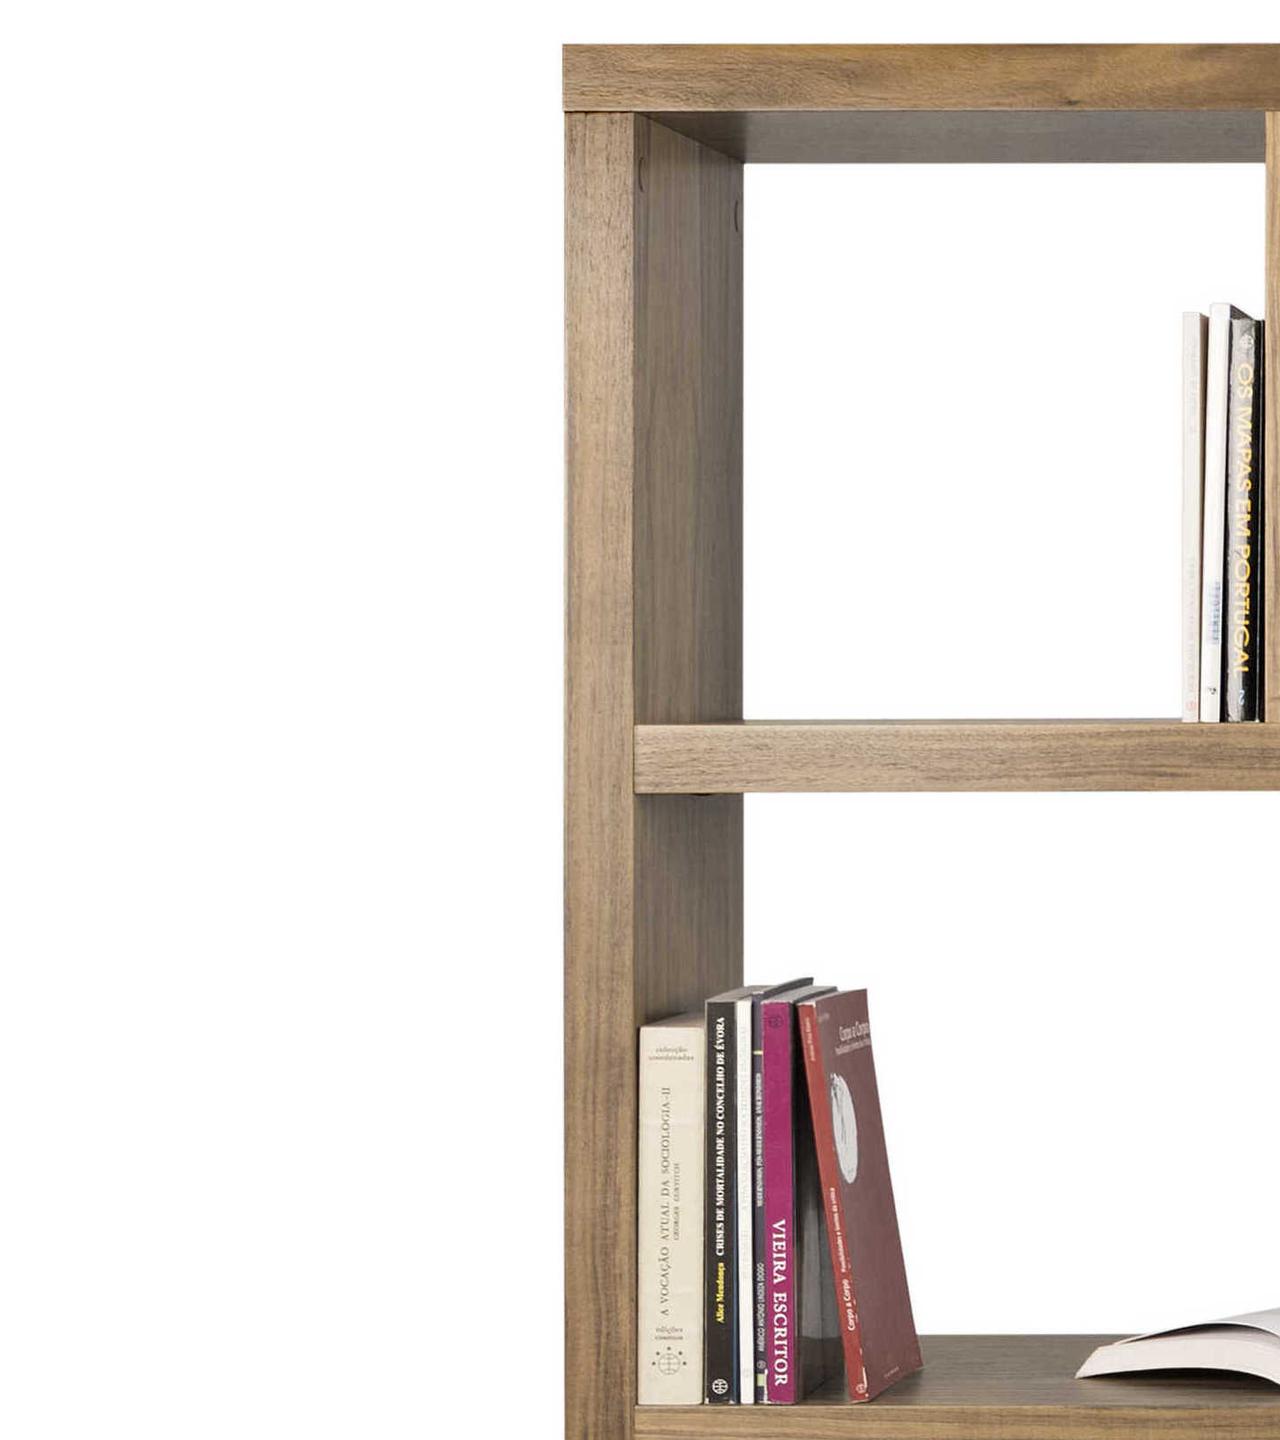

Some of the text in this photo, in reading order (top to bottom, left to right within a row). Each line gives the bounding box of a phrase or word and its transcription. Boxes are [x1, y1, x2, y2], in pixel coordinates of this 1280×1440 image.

[1232, 363, 1253, 677] OS MAPAS EM PORTUGAL
[714, 1017, 725, 1256] CRISES DE MORTALIDADE NO CONCELHO DE ÉVORA
[661, 1180, 669, 1196] DA
[660, 1203, 669, 1240] ATUAL
[658, 1247, 671, 1303] VOCAÇÃO
[716, 1262, 725, 1323] Alice Mendonça
[773, 1220, 787, 1384] VIEIRA ESCRITOR
[842, 1279, 851, 1301] Corpo
[847, 1309, 855, 1331] Corpo
